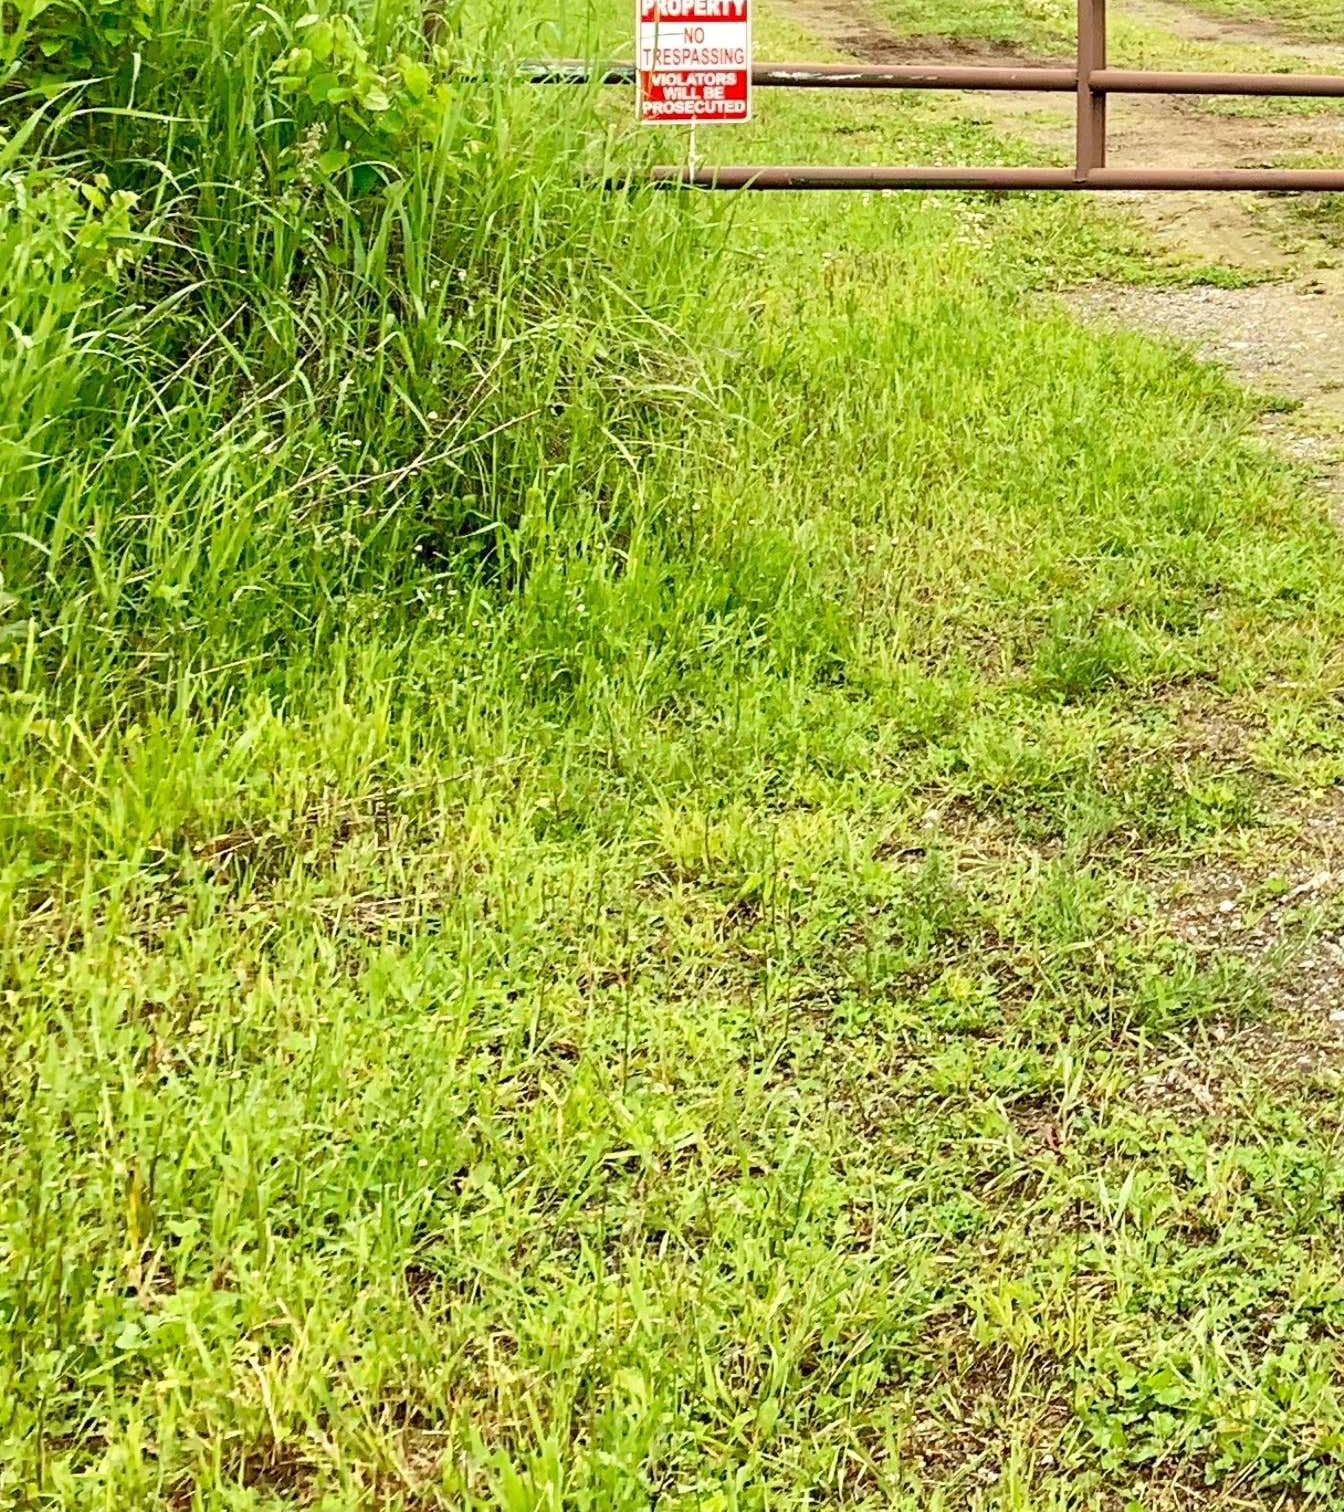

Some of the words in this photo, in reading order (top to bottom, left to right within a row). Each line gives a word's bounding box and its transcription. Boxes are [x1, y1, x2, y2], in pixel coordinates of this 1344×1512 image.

[684, 27, 705, 44] NO
[643, 48, 744, 65] TRESPASSING
[651, 73, 737, 87] VIOLATORS
[663, 87, 700, 100] WILL
[703, 86, 725, 99] BE
[642, 100, 745, 114] PROSECUTED
